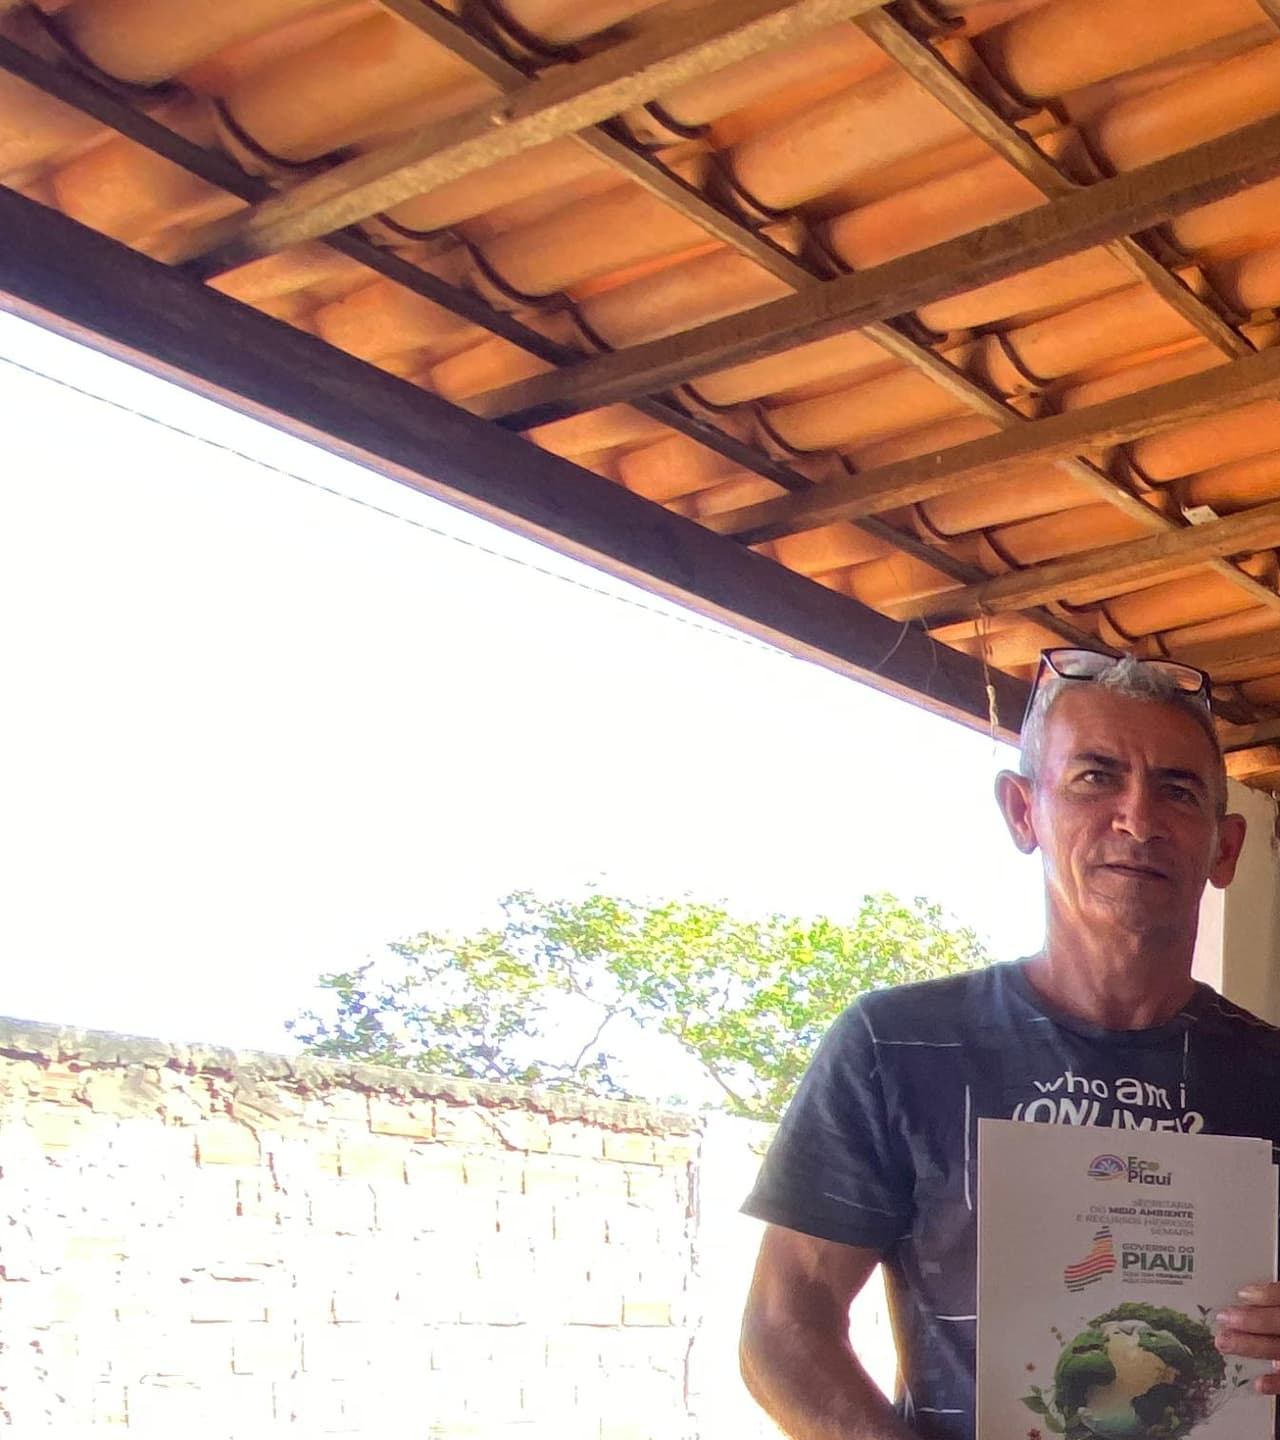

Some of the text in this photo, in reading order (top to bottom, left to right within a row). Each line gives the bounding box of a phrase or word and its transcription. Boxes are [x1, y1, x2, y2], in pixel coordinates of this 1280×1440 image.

[1033, 1071, 1187, 1111] who am i
[1127, 1156, 1160, 1171] Eco
[1108, 1207, 1137, 1215] MEIO
[1139, 1209, 1194, 1219] AMBIENTE
[1122, 1243, 1195, 1254] GOVERNO DO
